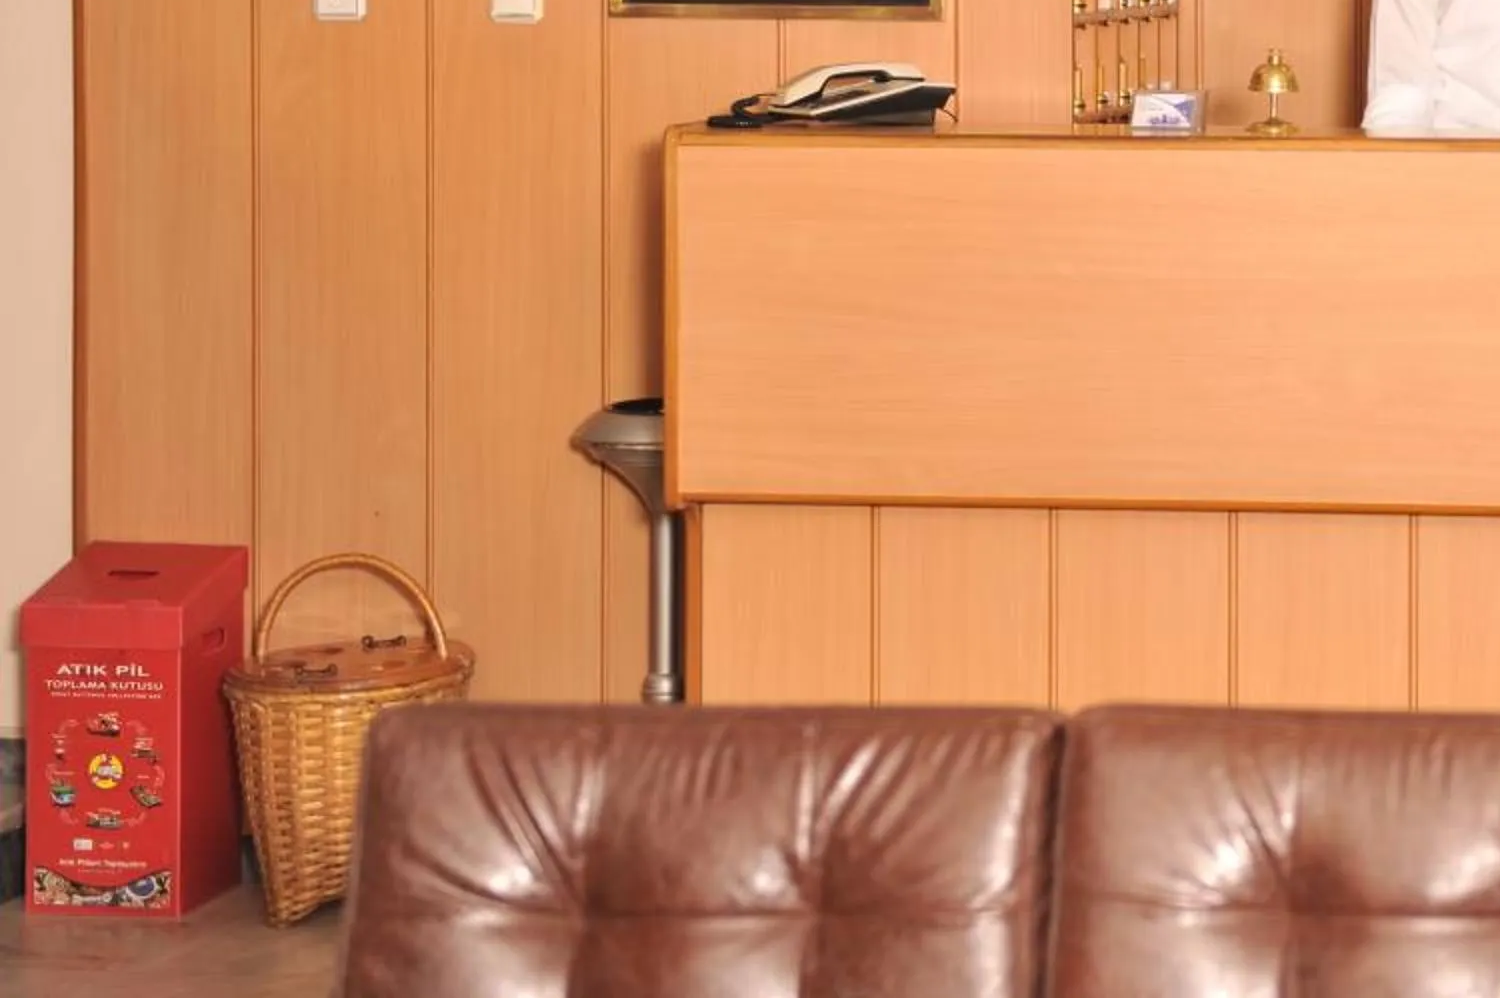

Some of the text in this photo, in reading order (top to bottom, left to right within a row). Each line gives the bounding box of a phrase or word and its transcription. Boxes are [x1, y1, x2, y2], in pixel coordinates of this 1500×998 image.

[57, 664, 107, 676] ATIK
[45, 679, 164, 692] TOPLAMA KUTUSU
